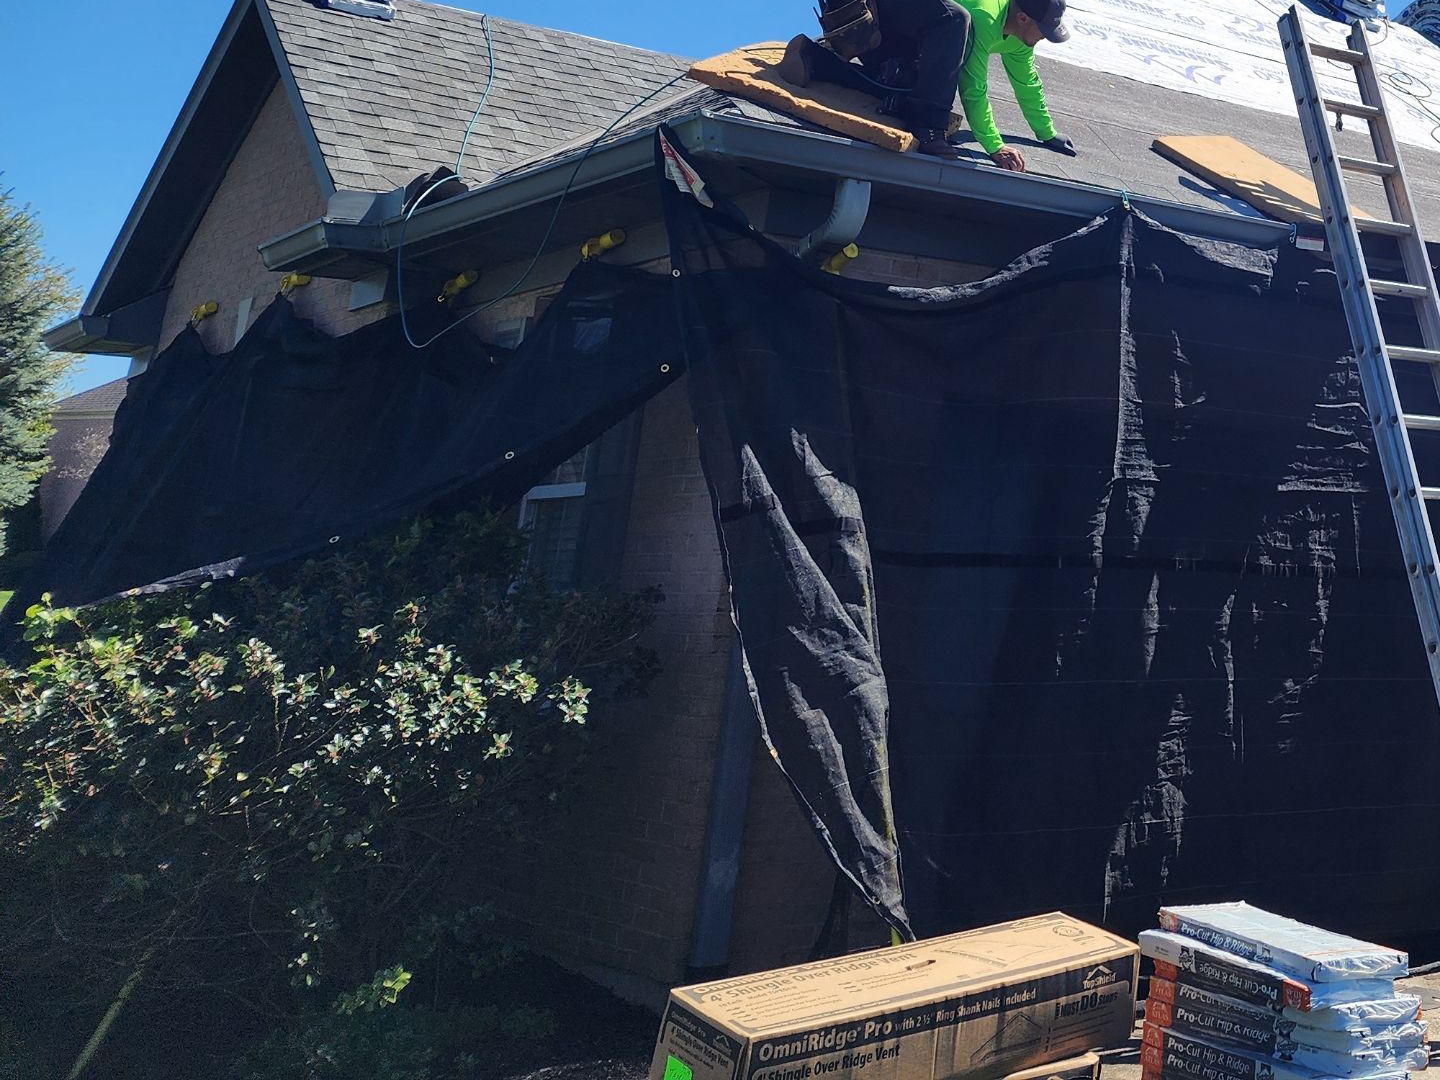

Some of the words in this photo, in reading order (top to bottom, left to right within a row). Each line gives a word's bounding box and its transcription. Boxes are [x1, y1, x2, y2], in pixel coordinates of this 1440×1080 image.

[1181, 922, 1209, 941] Pro-Cut
[1230, 938, 1253, 956] Ridge
[729, 977, 792, 999] Shingle
[793, 968, 831, 982] Over
[832, 958, 879, 976] Ridge
[879, 952, 918, 964] Vent
[1199, 963, 1225, 980] Ridge
[1244, 982, 1279, 1000] Pro-Cut
[863, 1021, 893, 1040] Pro
[936, 1009, 955, 1023] Ring
[957, 1003, 981, 1018] Shank
[1177, 1008, 1214, 1026] Pro-Cut
[768, 1064, 811, 1080] Shingle
[814, 1058, 840, 1076] Over
[842, 1053, 873, 1068] Ridge
[875, 1044, 900, 1061] Vent
[1167, 1054, 1200, 1074] Pro-Cut
[1168, 1037, 1200, 1058] Pro-Cut
[1203, 1048, 1217, 1065] Hip
[1217, 1053, 1225, 1064] &
[1227, 1055, 1250, 1074] Ridge
